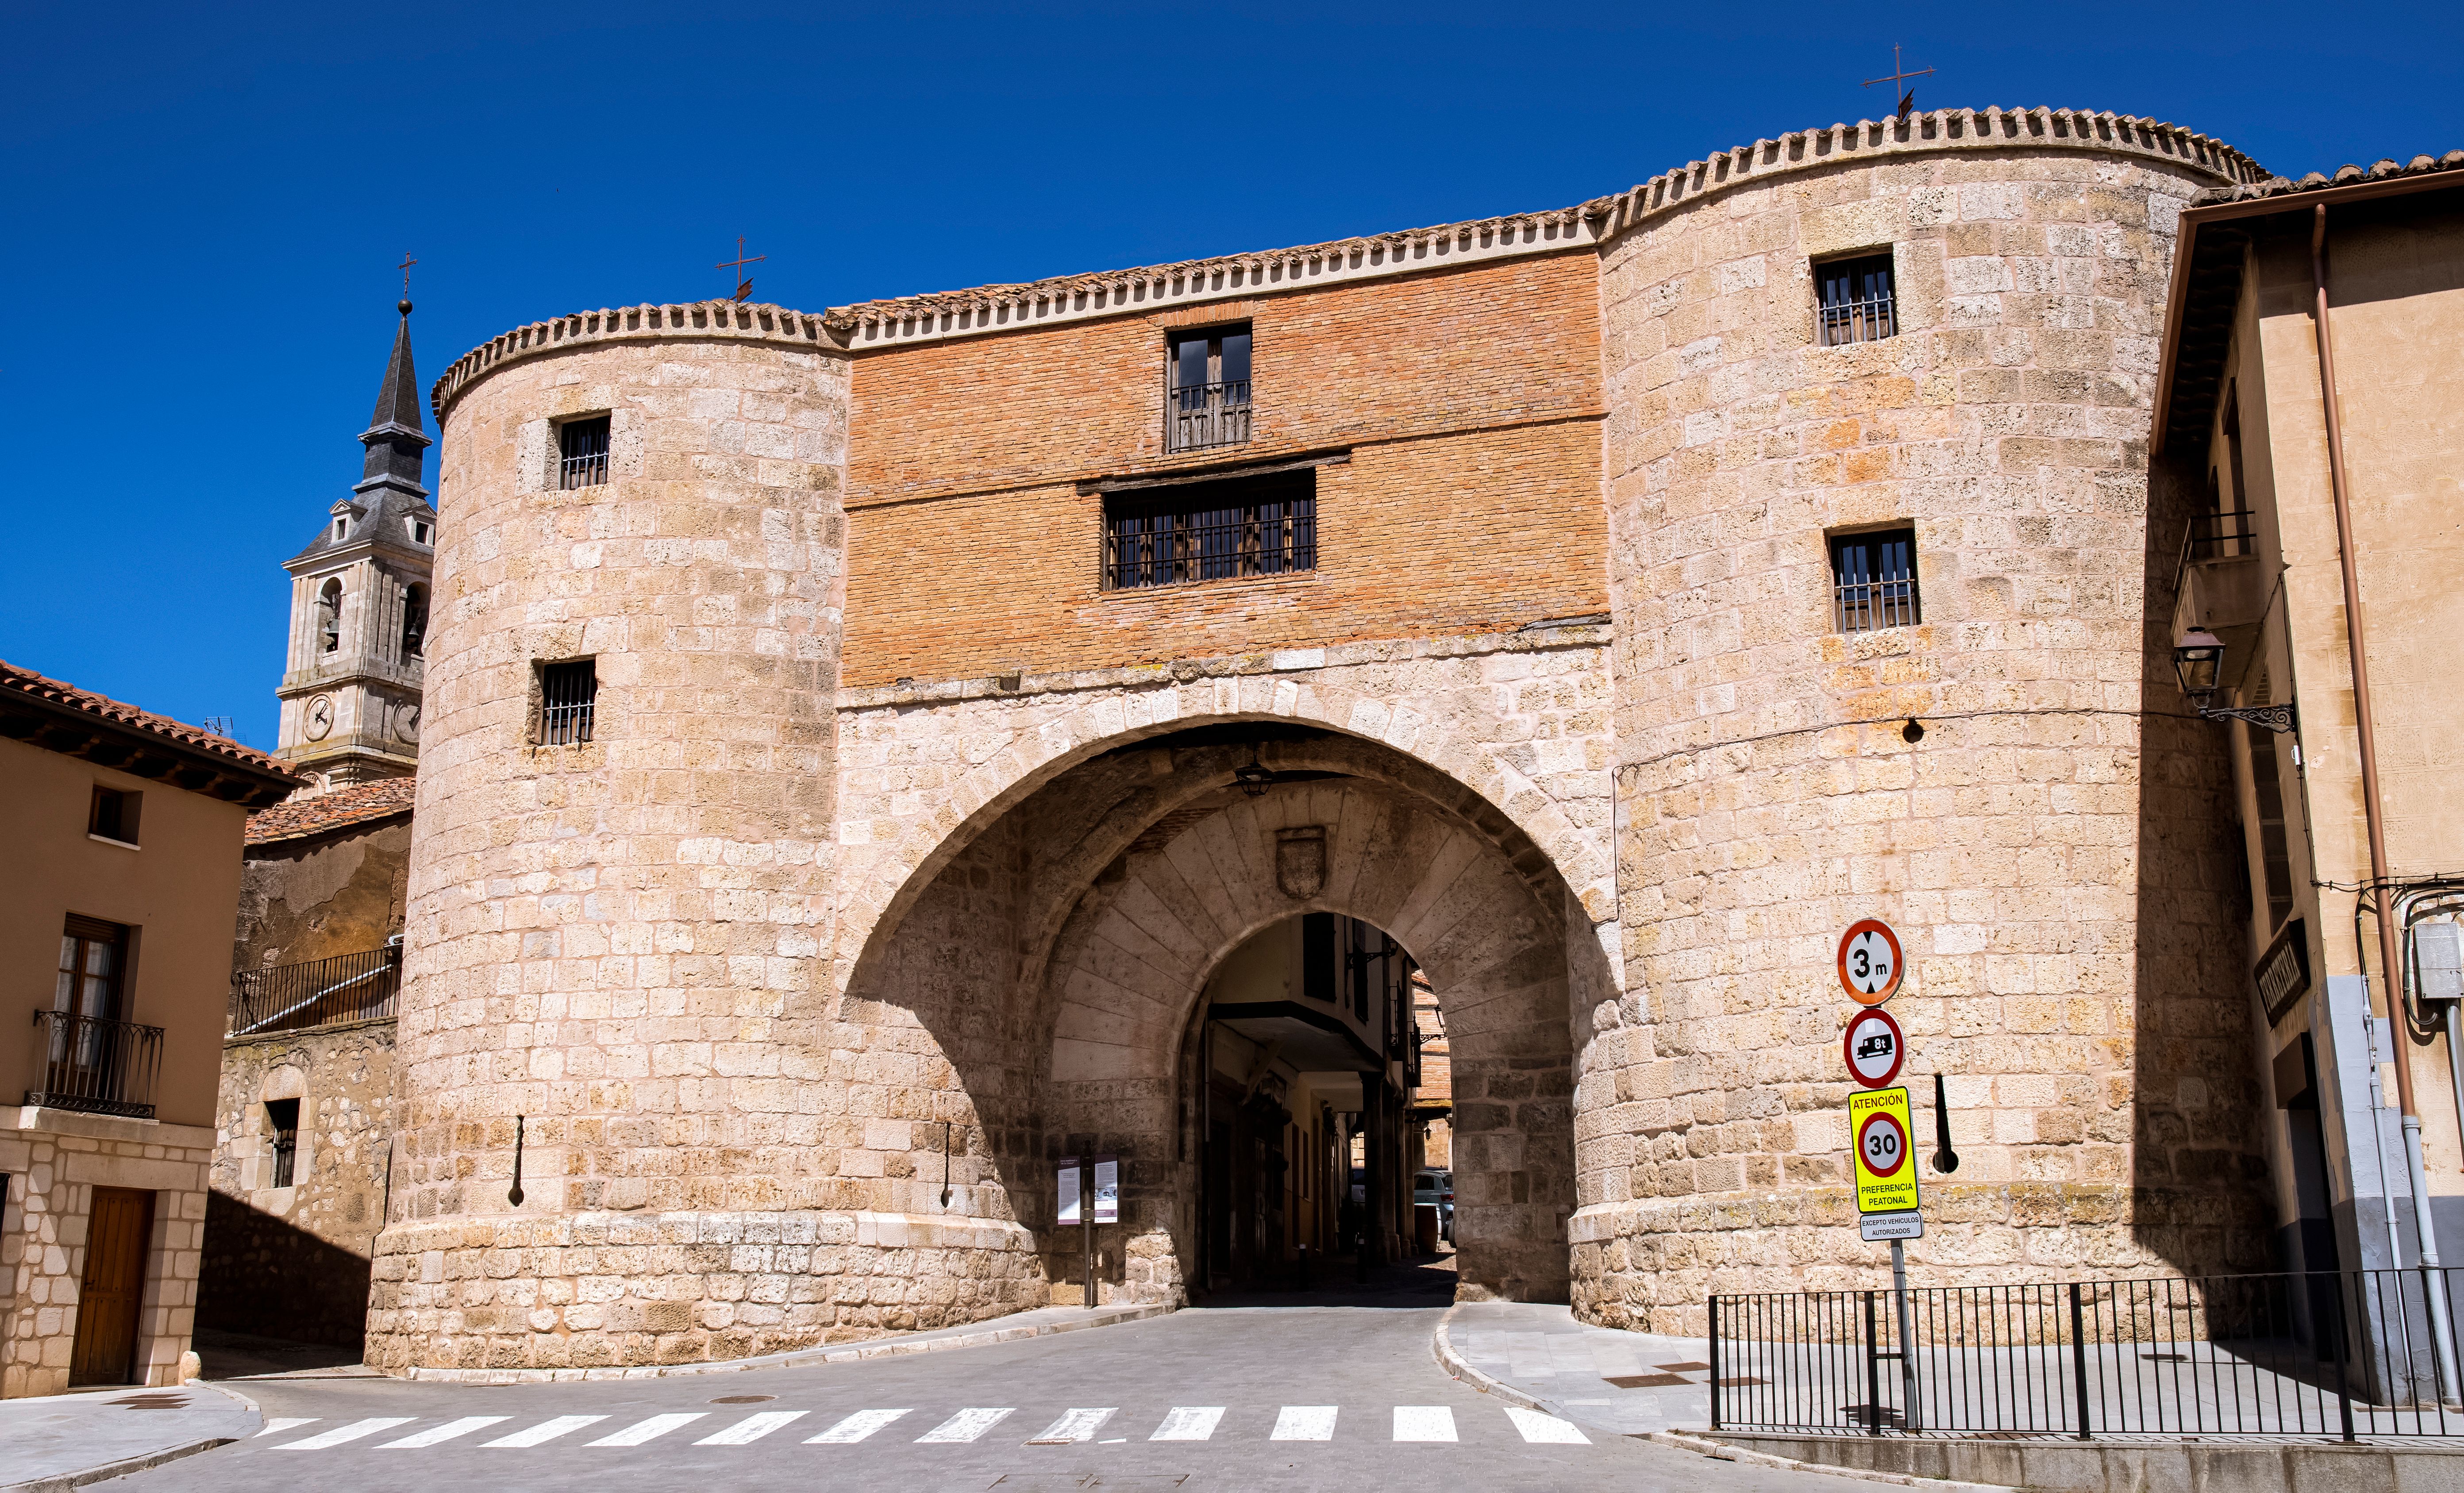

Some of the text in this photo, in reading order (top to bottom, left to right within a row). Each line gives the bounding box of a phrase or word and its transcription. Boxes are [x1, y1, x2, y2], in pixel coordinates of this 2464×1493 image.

[1853, 948, 1887, 978] 3 m
[2259, 940, 2301, 1014] FERRETERIA
[1874, 1039, 1886, 1049] 8t
[1853, 1093, 1903, 1110] ATENCIÓN
[1869, 1134, 1896, 1156] 30
[1861, 1183, 1913, 1194] PREFERENCIA
[1868, 1196, 1908, 1206] PEATONAL
[1862, 1216, 1919, 1226] EXCEPTO VEHÍCULOS
[1872, 1226, 1910, 1235] AUTORIZADOS
